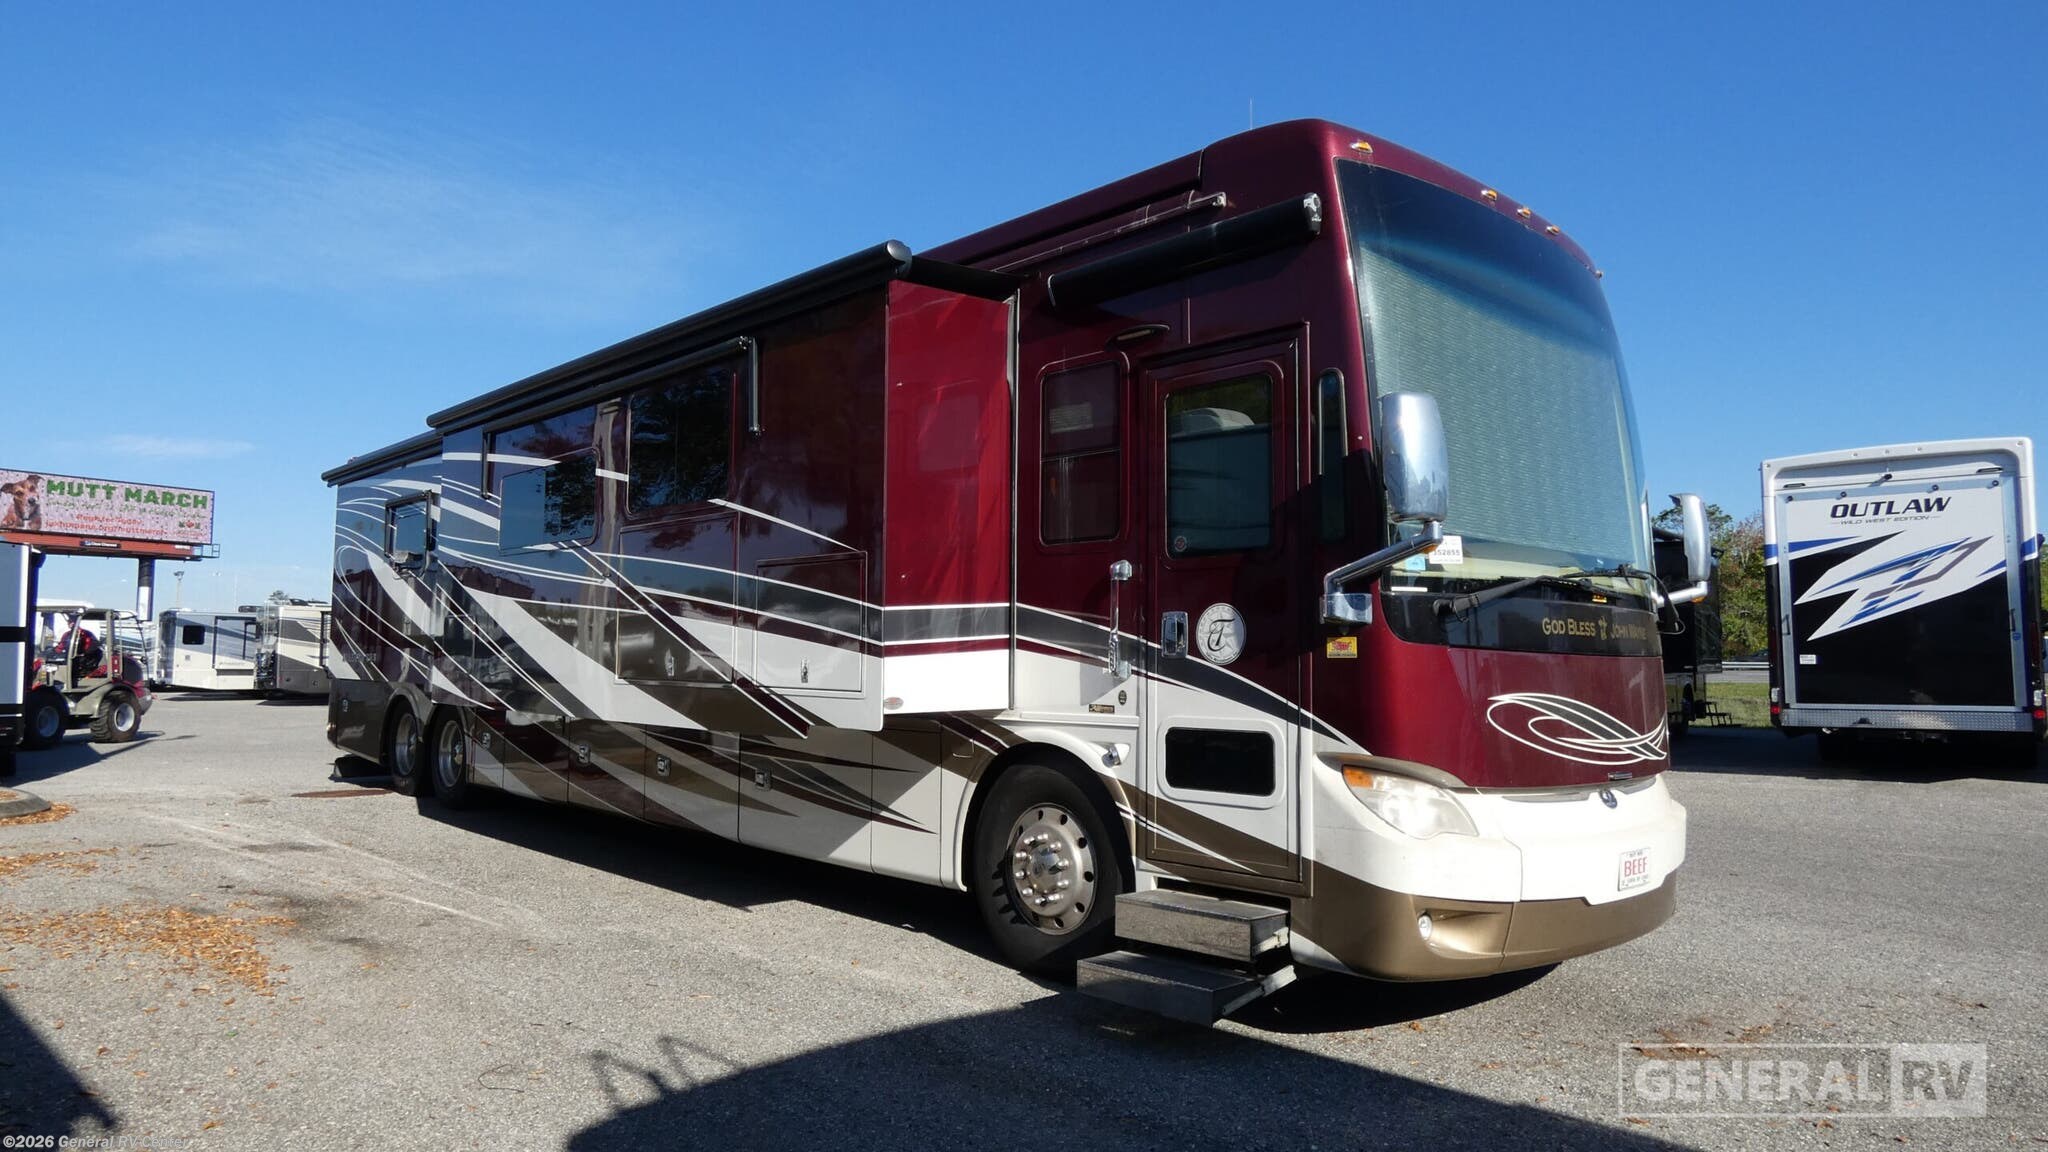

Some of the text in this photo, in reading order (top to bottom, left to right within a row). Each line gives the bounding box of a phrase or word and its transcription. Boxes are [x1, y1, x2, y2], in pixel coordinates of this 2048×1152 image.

[46, 479, 117, 500] MUTT
[125, 487, 209, 509] MARCH
[1830, 496, 1951, 518] OUTLAW
[1542, 617, 1566, 635] GOD
[1567, 619, 1596, 637] BLESS
[1624, 856, 1648, 877] BEEF
